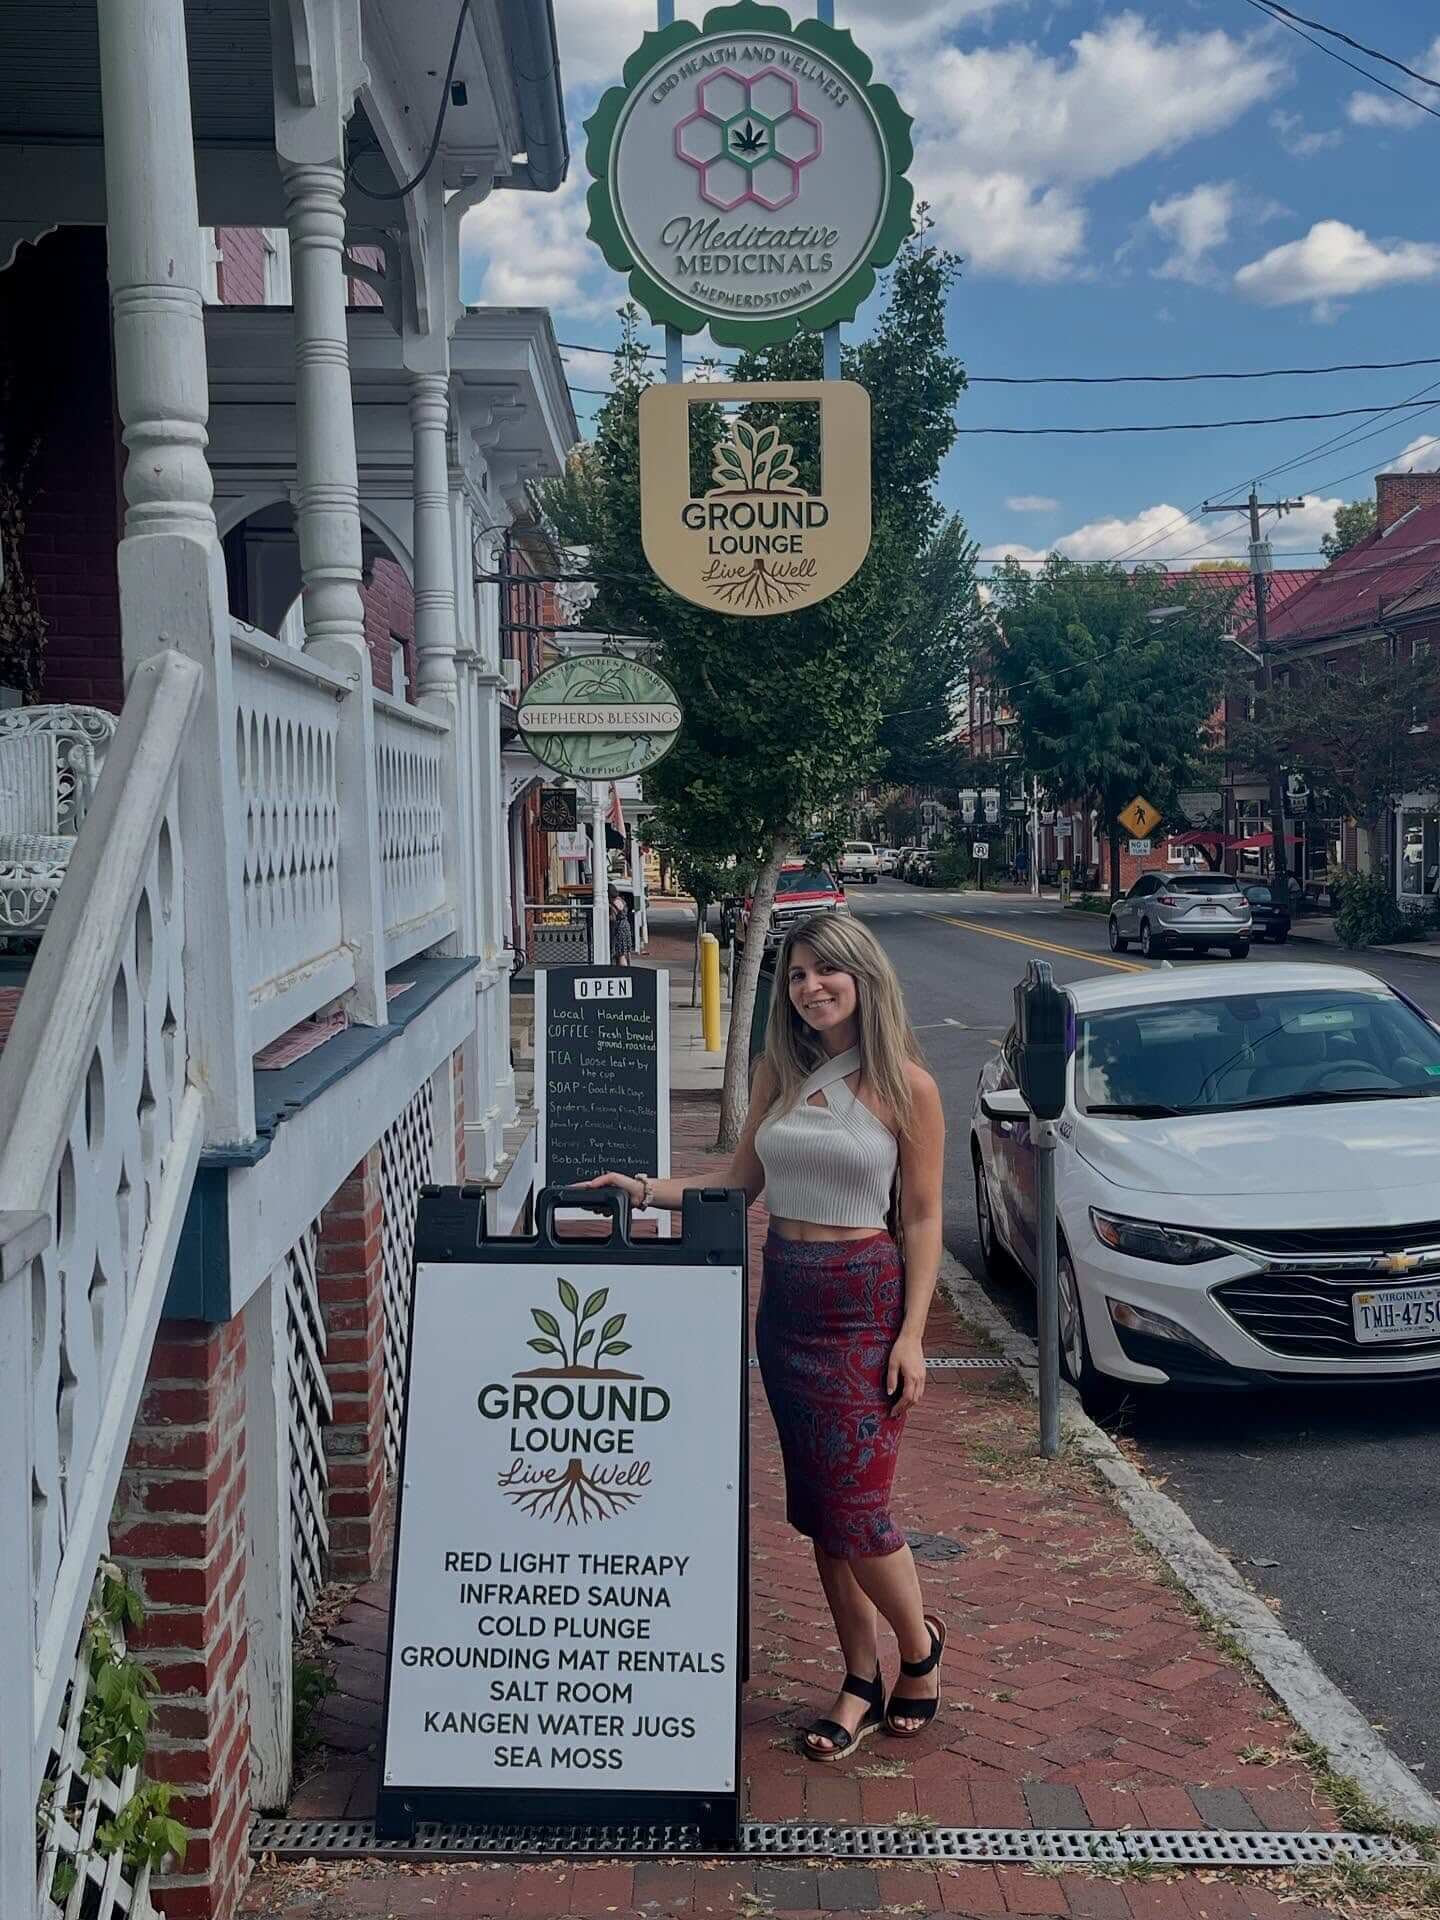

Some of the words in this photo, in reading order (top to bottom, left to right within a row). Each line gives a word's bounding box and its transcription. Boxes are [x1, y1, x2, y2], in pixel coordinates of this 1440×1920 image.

[652, 73, 679, 104] CBD
[679, 46, 737, 80] HEALTH
[741, 46, 776, 62] AND
[780, 50, 849, 106] WELLNESS
[662, 216, 840, 251] Meditative
[676, 252, 833, 275] MEDICINALS
[690, 280, 813, 307] SHEPHERDSTOWN
[681, 501, 829, 531] GROUND
[708, 534, 803, 555] LOUNGE
[702, 559, 751, 582] Live
[770, 558, 818, 579] Well
[522, 711, 604, 726] SHEPHERDS
[607, 711, 680, 726] BLESSINGS
[578, 765, 622, 775] KEEPING
[580, 980, 628, 998] OPEN
[553, 1007, 584, 1020] Local
[597, 1008, 652, 1023] Handmade
[548, 1024, 590, 1038] COFFEE
[598, 1025, 622, 1039] Fresh
[548, 1050, 573, 1065] TEA
[580, 1052, 607, 1067] Loose
[637, 1058, 649, 1072] by
[582, 1068, 597, 1078] the
[599, 1071, 616, 1081] cup
[549, 1081, 580, 1094] SOAP
[1376, 1290, 1425, 1302] VIRGINIA
[477, 1384, 671, 1422] GROUND
[510, 1427, 634, 1454] LOUNGE
[497, 1457, 562, 1487] Live
[591, 1460, 652, 1486] Well
[445, 1551, 492, 1573] RED
[500, 1552, 570, 1574] LIGHT
[578, 1553, 690, 1577] THERAPY
[460, 1583, 580, 1606] INFRARED
[588, 1586, 672, 1608] SAUNA
[478, 1616, 546, 1637] COLD
[554, 1618, 651, 1640] PLUNGE
[401, 1646, 550, 1669] GROUNDING
[558, 1650, 610, 1671] MAT
[617, 1652, 725, 1673] RENTALS
[490, 1680, 549, 1702] SALT
[556, 1682, 633, 1704] ROOM
[424, 1711, 529, 1735] KANGEN
[537, 1714, 625, 1737] WATER
[632, 1716, 696, 1738] JUGS
[494, 1746, 542, 1768] SEA
[551, 1747, 623, 1769] MOSS
